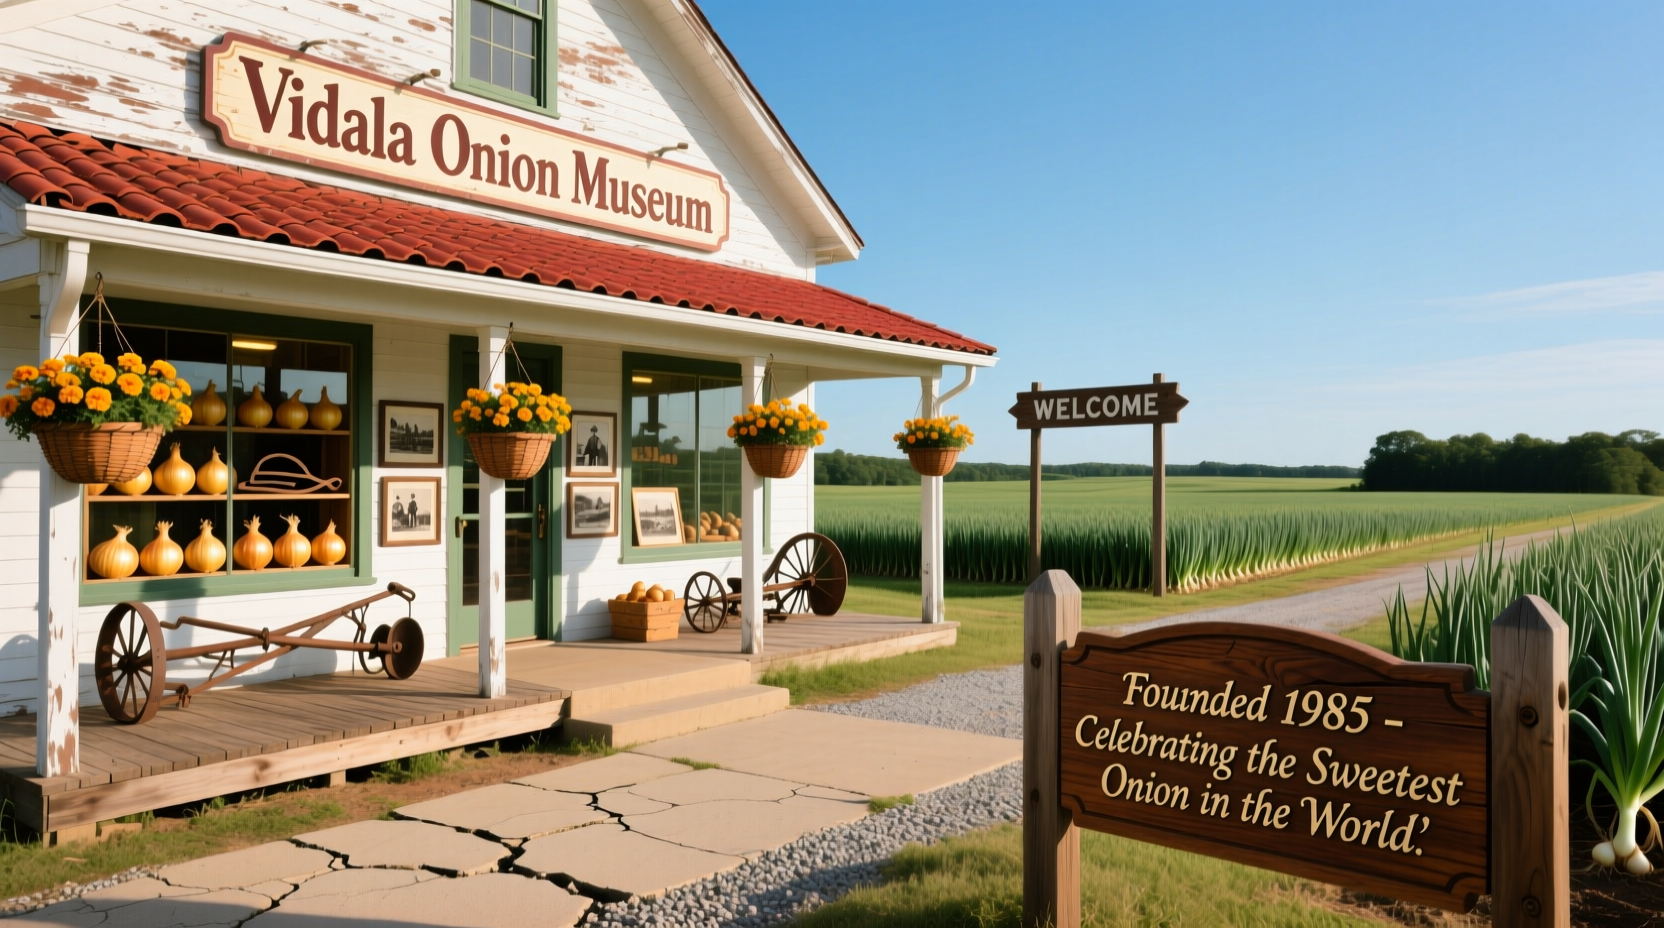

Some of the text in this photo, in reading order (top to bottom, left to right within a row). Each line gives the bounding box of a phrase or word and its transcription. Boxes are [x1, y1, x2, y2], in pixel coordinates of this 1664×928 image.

[238, 54, 713, 235] Vidala Onion Museum
[1033, 392, 1159, 421] WELCOME
[1280, 689, 1374, 734] 1985
[1074, 714, 1464, 806] Celebrating the Sweetest
[1100, 763, 1190, 810] Onion
[1200, 783, 1231, 819] in
[1240, 788, 1290, 829] the
